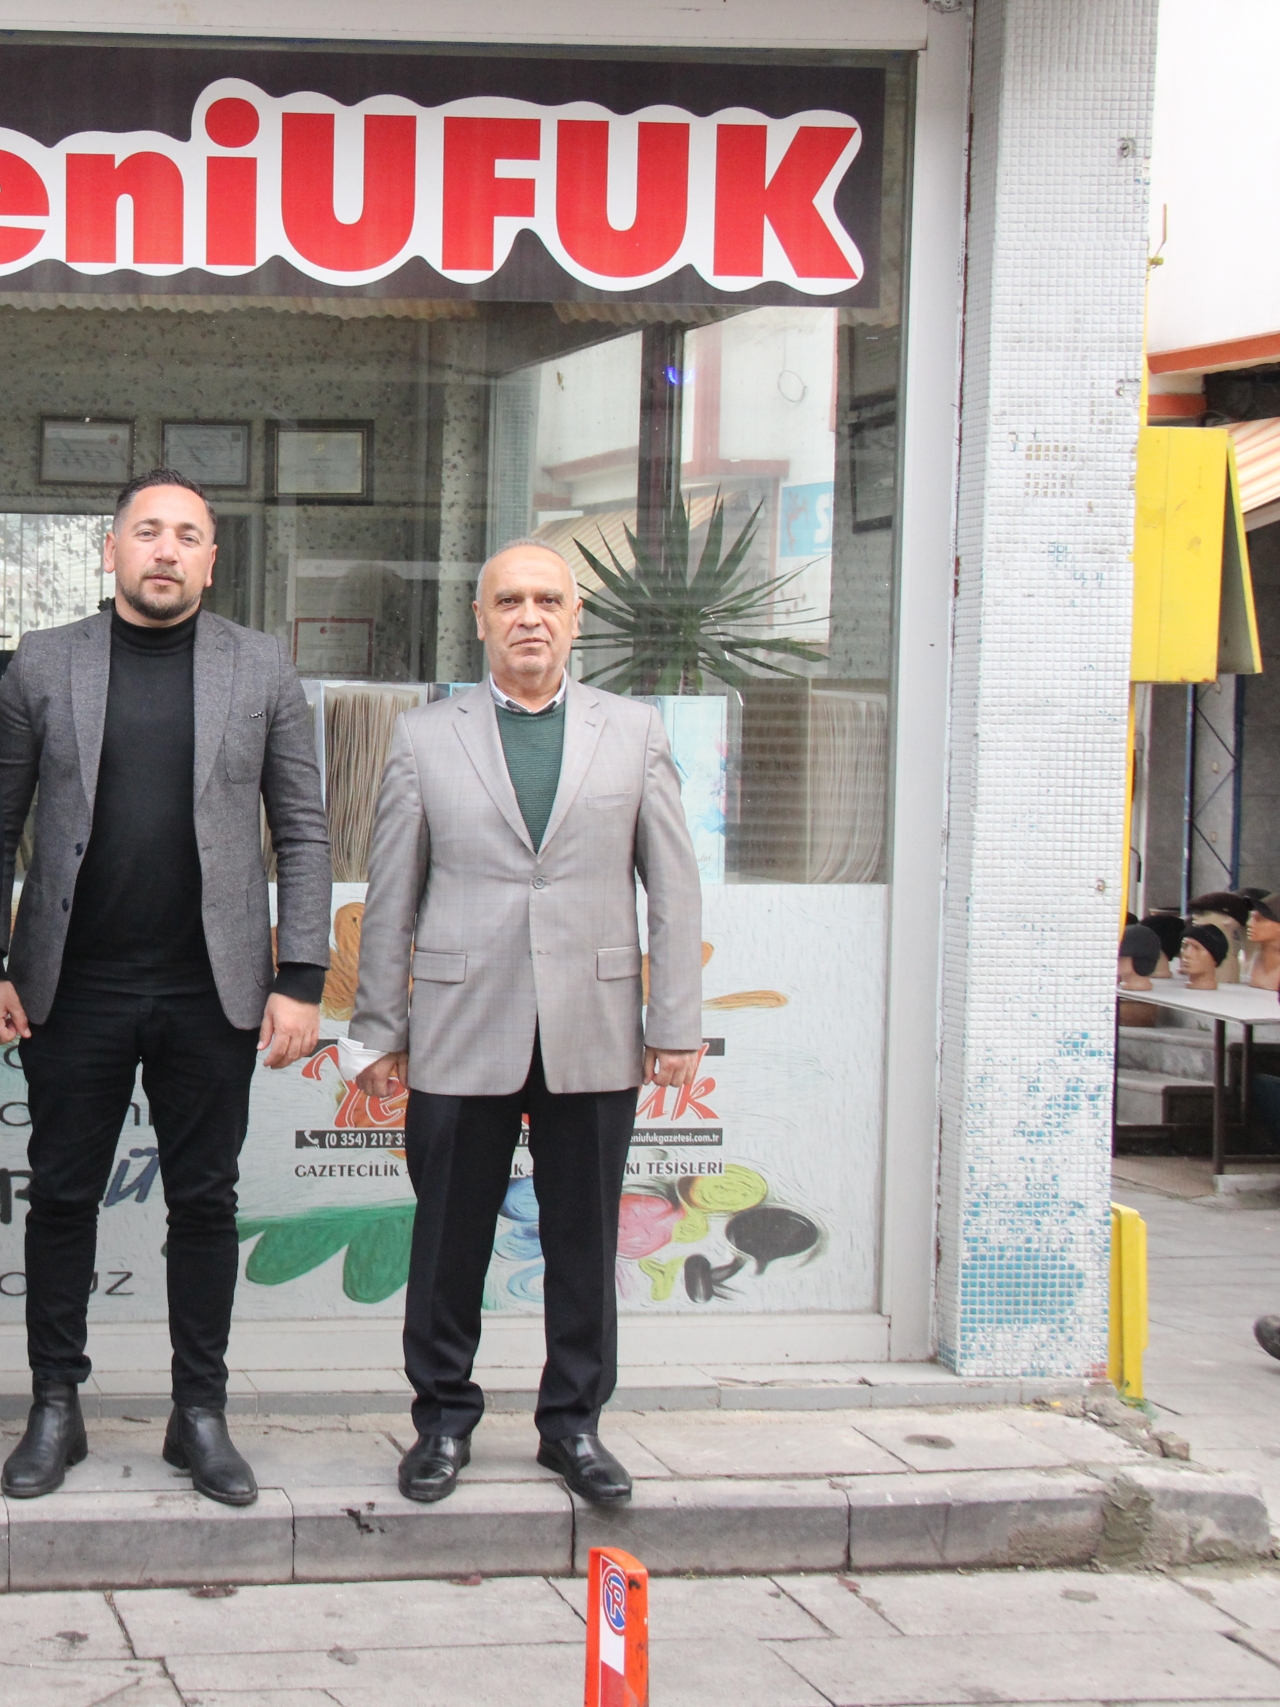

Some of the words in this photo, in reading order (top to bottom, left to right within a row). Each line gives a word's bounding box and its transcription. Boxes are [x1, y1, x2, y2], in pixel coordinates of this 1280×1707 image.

[325, 1132, 337, 1149] (0
[340, 1132, 367, 1149] 354)
[294, 1161, 400, 1178] GAZETECİLİK
[646, 1158, 723, 1176] TESİSLERİ
